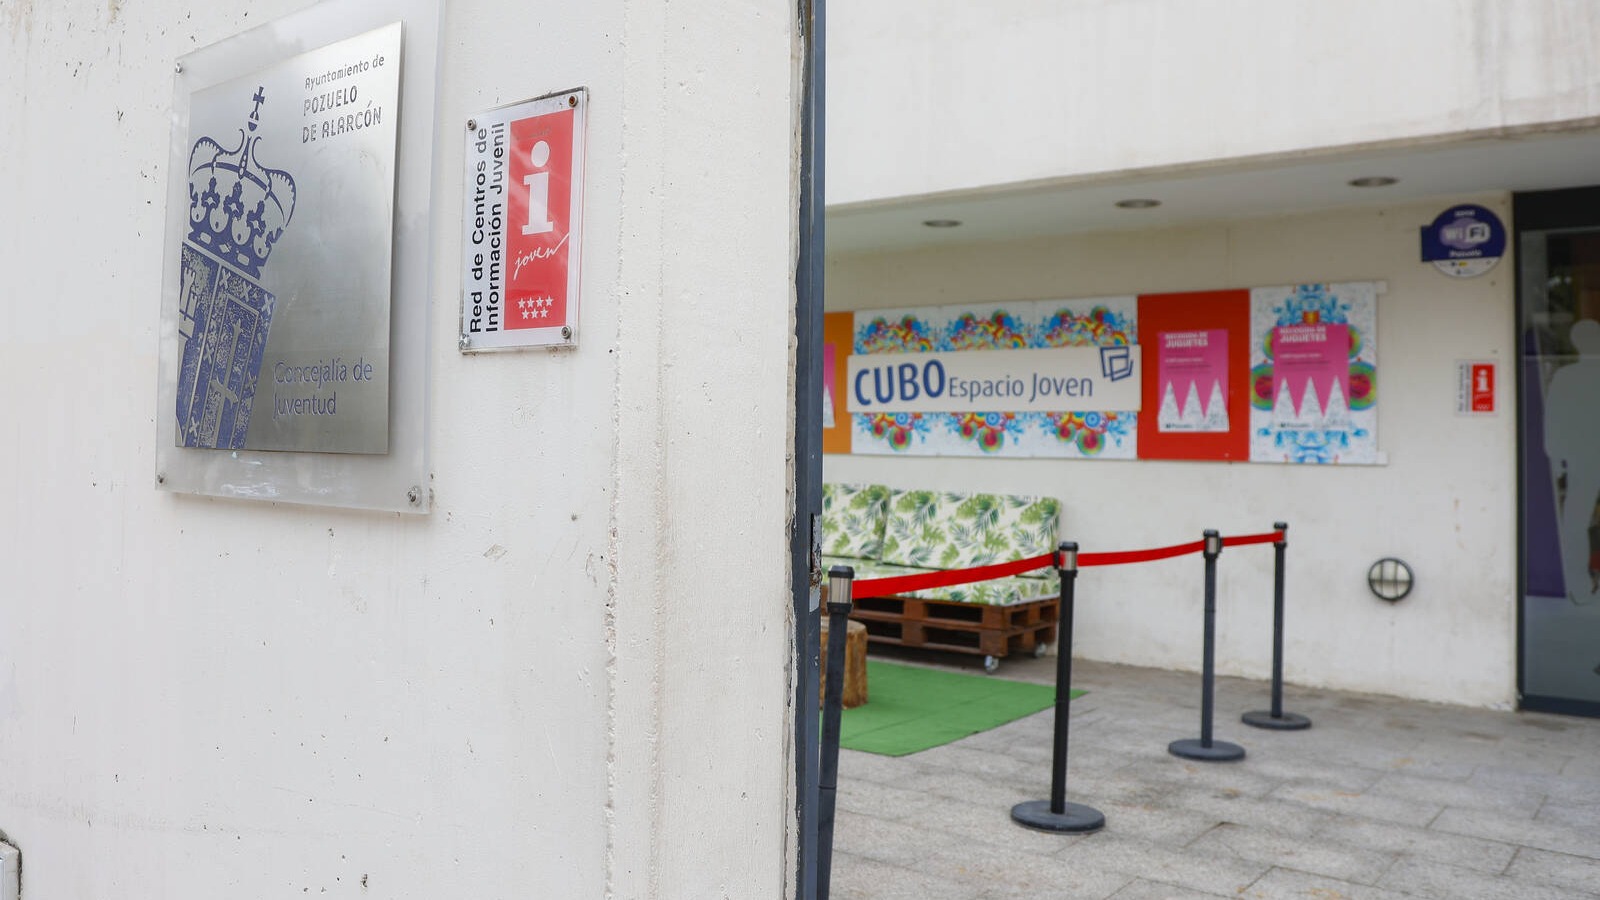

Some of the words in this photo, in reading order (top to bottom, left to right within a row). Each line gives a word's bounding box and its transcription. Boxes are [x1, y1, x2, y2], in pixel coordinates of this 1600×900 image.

[305, 60, 369, 91] Ayuntamiento
[372, 54, 385, 68] de
[303, 85, 357, 116] POZUELO
[302, 124, 317, 144] DE
[322, 100, 381, 138] ALARCÓN
[475, 128, 487, 153] de
[490, 122, 504, 195] Juvenil
[472, 160, 486, 245] Centros
[472, 253, 483, 280] de
[486, 203, 502, 332] Información
[513, 232, 570, 281] joven
[470, 291, 482, 333] Red
[1165, 338, 1208, 348] JUGUETES
[1280, 332, 1327, 343] JUGUETES
[274, 357, 347, 389] Concejalía
[353, 357, 373, 381] de
[854, 358, 946, 406] CUBO
[949, 375, 1025, 403] Espacio
[1028, 373, 1093, 403] Joven
[273, 390, 337, 420] Juventud
